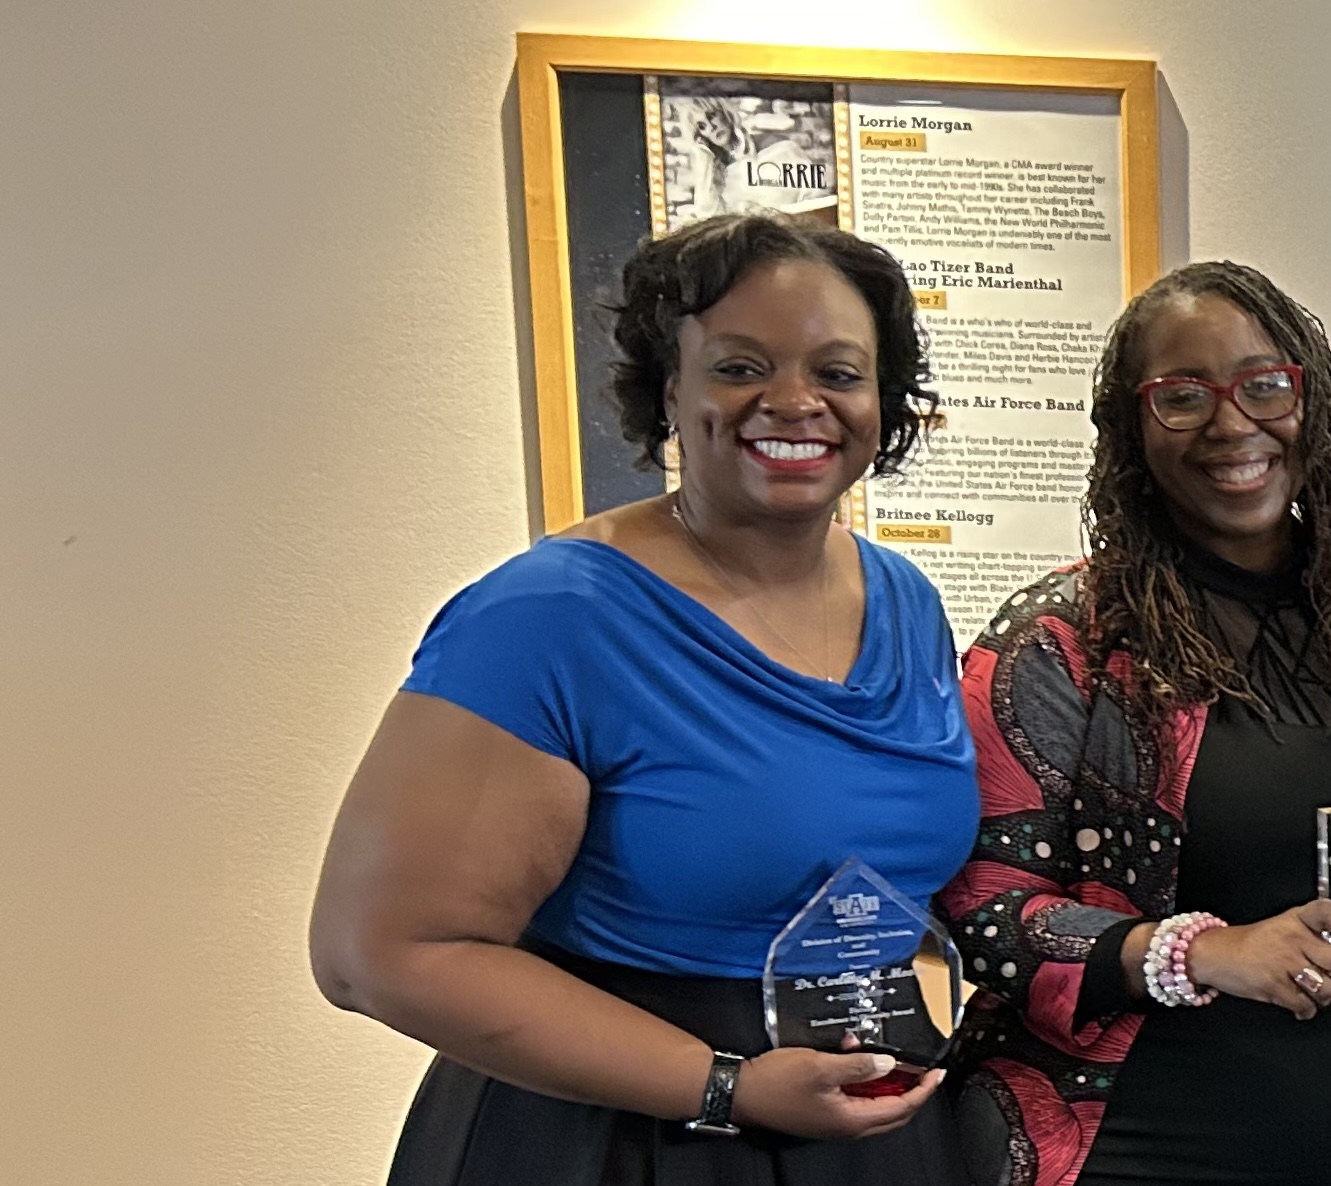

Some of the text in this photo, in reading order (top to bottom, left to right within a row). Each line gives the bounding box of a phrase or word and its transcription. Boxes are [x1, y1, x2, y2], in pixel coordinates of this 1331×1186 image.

[859, 115, 972, 133] Lorrie Morgan
[865, 136, 917, 148] August 31
[860, 154, 894, 165] Country
[896, 157, 936, 166] superstar
[1012, 160, 1032, 169] CMA
[1034, 162, 1062, 170] award
[916, 168, 952, 178] platinum
[1027, 172, 1046, 180] best
[1092, 174, 1106, 184] her
[889, 178, 908, 187] from
[911, 180, 924, 188] the
[927, 180, 948, 190] early
[950, 180, 958, 189] to
[1007, 182, 1024, 192] She
[1026, 184, 1041, 192] has
[1044, 184, 1095, 195] collaborated
[1030, 196, 1068, 207] including
[1070, 197, 1094, 206] Frank
[1034, 207, 1050, 216] The
[1052, 207, 1080, 217] Beach
[920, 214, 941, 224] Andy
[984, 217, 998, 226] the
[1000, 217, 1020, 226] New
[1022, 218, 1048, 228] World
[882, 224, 900, 233] Pam
[954, 226, 988, 238] Morgan
[930, 260, 971, 273] Tizer
[975, 262, 1014, 275] Band
[942, 274, 974, 288] Eric
[978, 276, 1063, 291] Marienthal
[973, 396, 996, 408] Air
[1000, 398, 1041, 410] Force
[1046, 398, 1085, 412] Band
[876, 508, 994, 526] Britnee Kellogg
[882, 528, 925, 538] October
